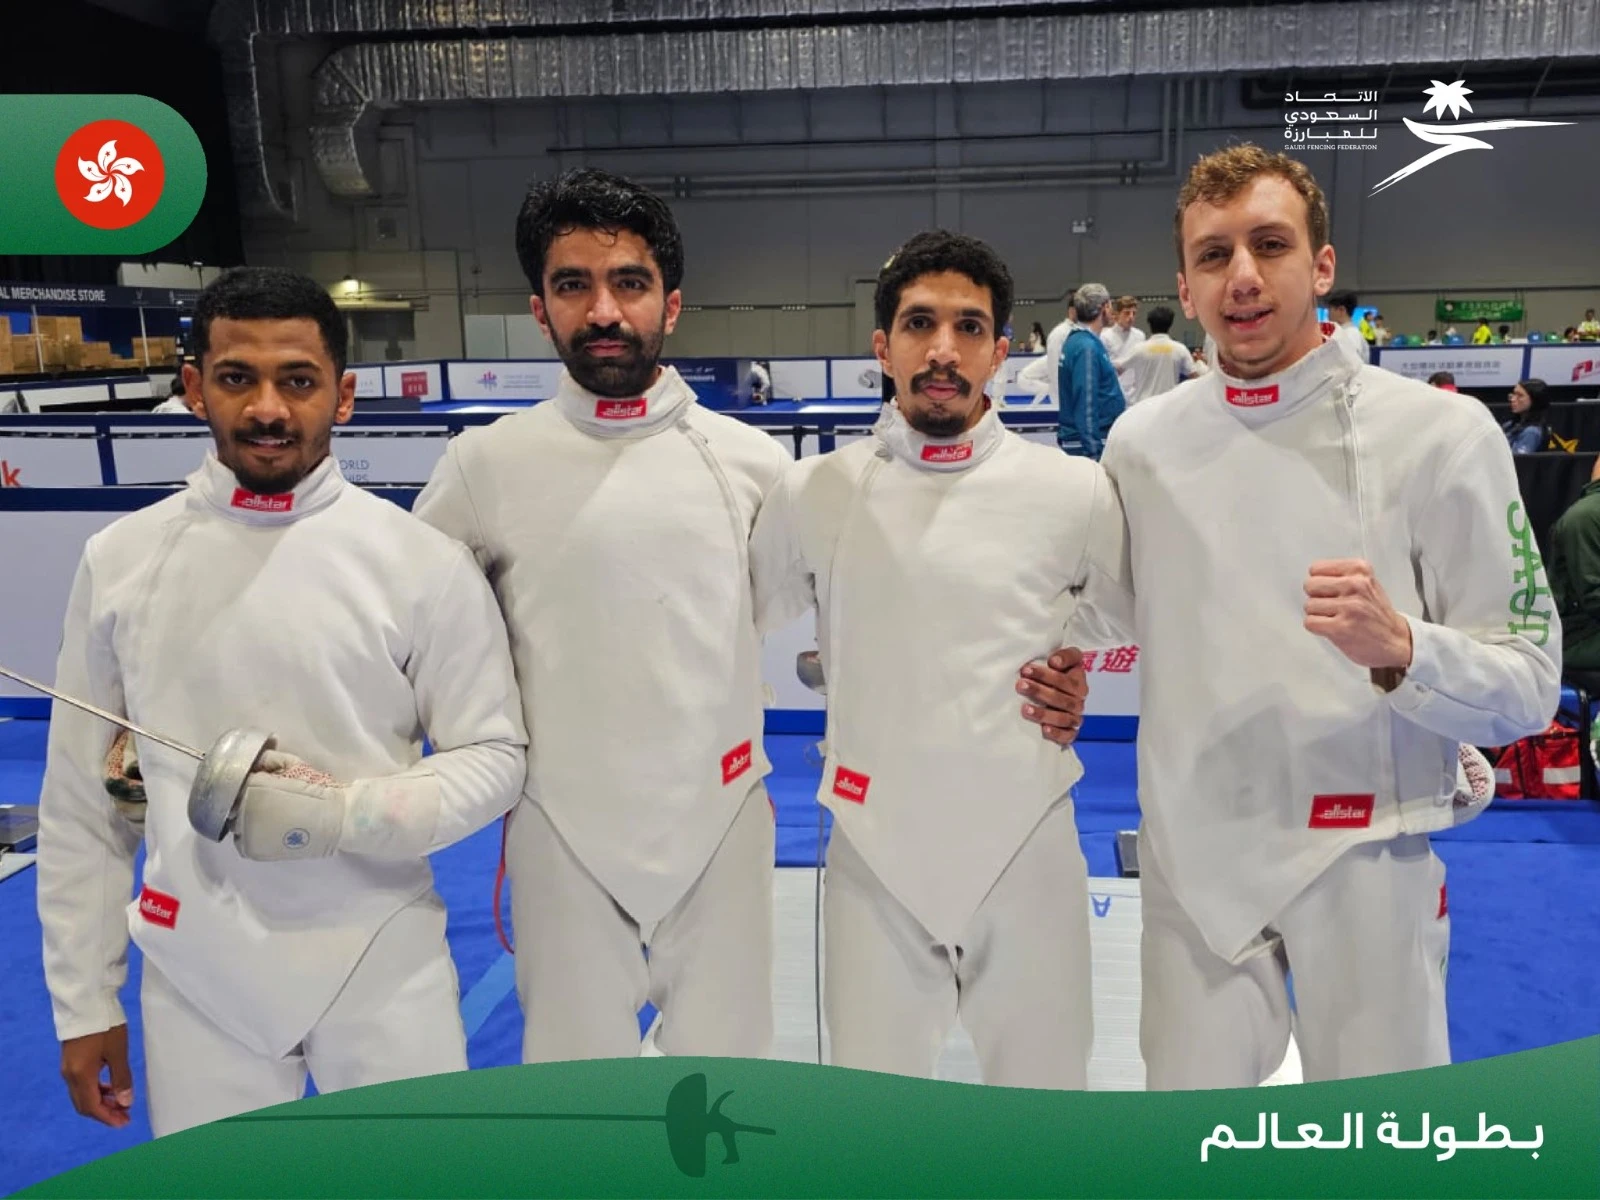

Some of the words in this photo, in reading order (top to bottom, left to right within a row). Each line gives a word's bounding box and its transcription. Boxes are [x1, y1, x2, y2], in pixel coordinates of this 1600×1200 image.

[11, 286, 77, 301] MERCHANDISE
[78, 289, 106, 301] STORE
[1232, 391, 1274, 405] allstar
[242, 494, 288, 509] allstar
[1318, 803, 1367, 820] allstar
